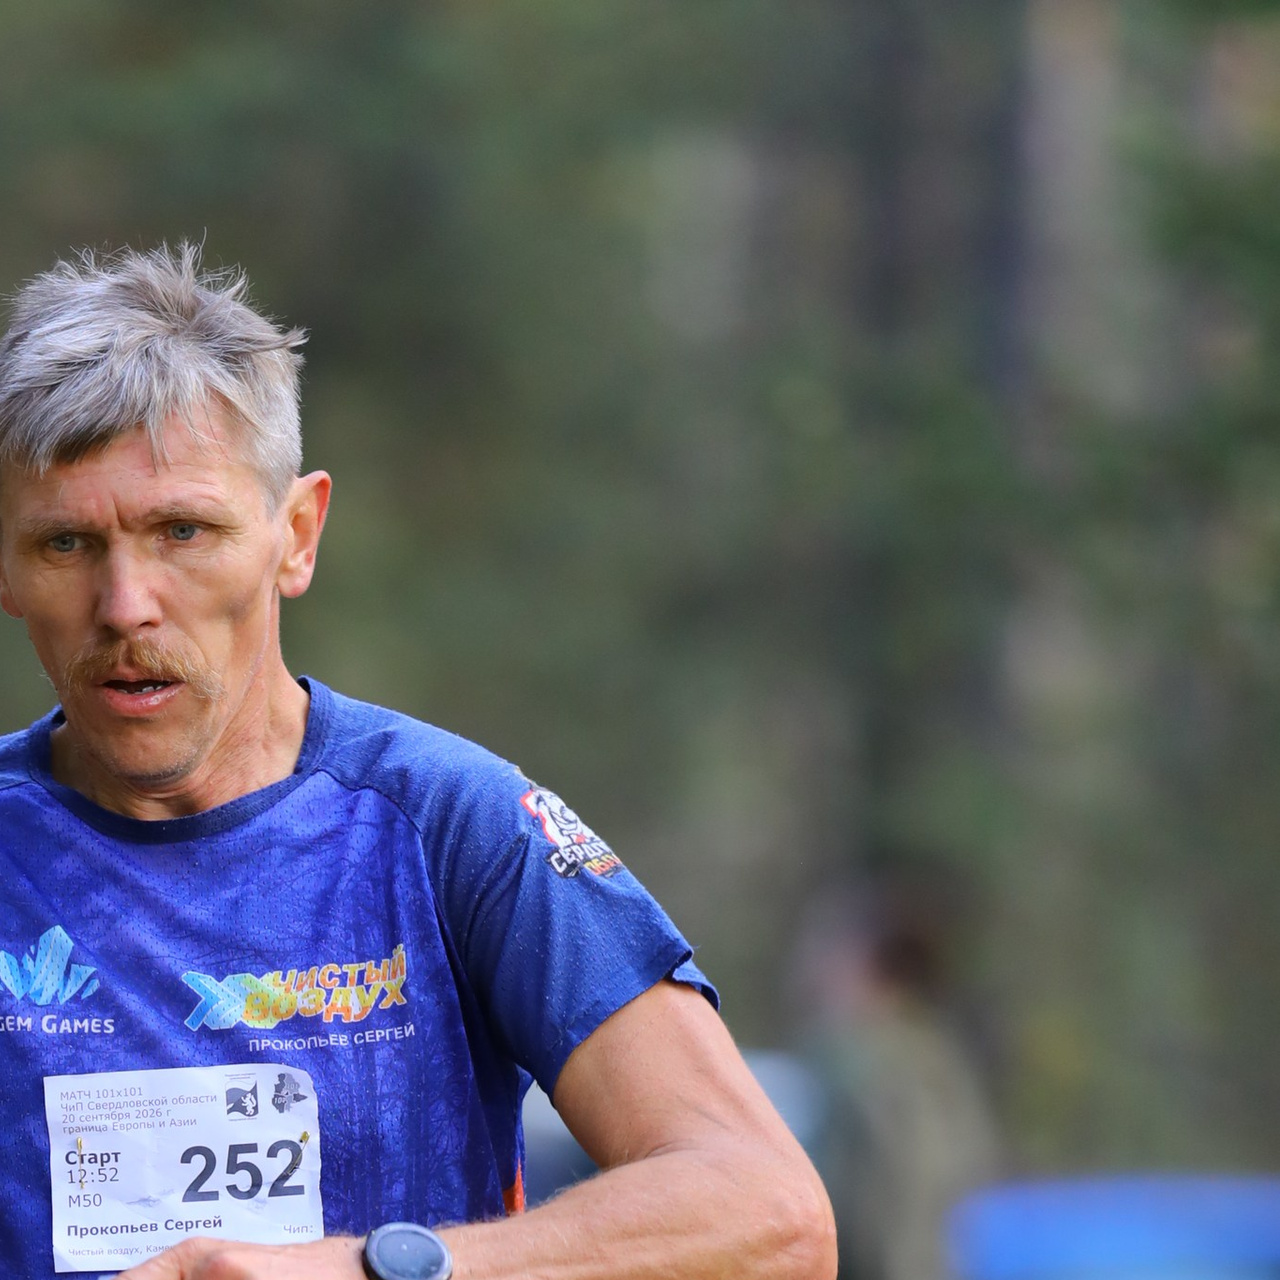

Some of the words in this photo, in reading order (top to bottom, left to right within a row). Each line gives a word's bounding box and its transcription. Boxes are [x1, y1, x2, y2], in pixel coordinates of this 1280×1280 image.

[271, 943, 407, 994] ЧИСТЫЙ
[241, 978, 408, 1023] ВОЗДУХ
[249, 1033, 350, 1052] ПРОКОПЬЕВ
[353, 1021, 416, 1045] СЕРГЕЙ
[60, 1090, 91, 1101] МАТЧ
[60, 1101, 84, 1112] ЧиП
[87, 1096, 168, 1111] Свердловской
[171, 1094, 217, 1105] области
[61, 1113, 76, 1124] 20
[79, 1110, 131, 1122] сентября
[62, 1124, 108, 1135] граница
[112, 1121, 155, 1132] Европы
[169, 1118, 197, 1128] Азии
[65, 1150, 121, 1167] Старт
[67, 1167, 120, 1184] 12:52
[180, 1139, 305, 1202] 252
[67, 1222, 158, 1239] Прокопьев
[164, 1215, 222, 1232] Сергей
[283, 1224, 314, 1234] Чип:
[68, 1247, 104, 1256] Чистый
